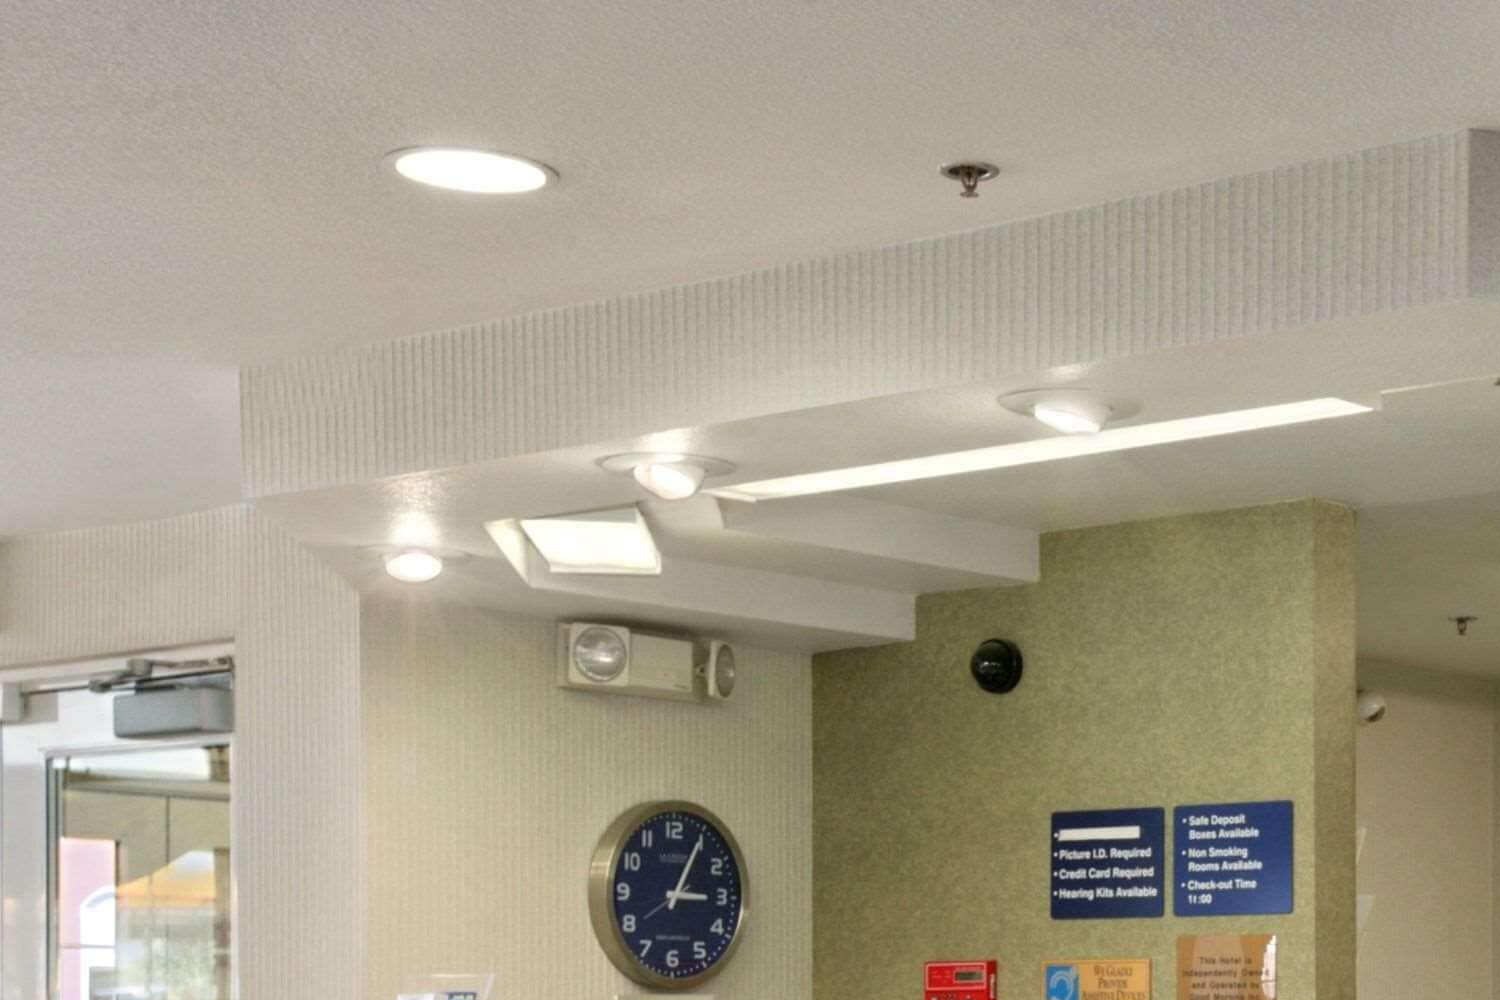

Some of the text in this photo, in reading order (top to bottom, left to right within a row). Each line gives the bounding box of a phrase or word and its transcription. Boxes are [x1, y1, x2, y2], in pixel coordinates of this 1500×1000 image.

[1188, 814, 1246, 826] Safe Deposit
[641, 829, 653, 847] 11
[665, 821, 684, 839] 12
[1189, 827, 1260, 840] Boxes Available
[1059, 847, 1152, 860] Picture I.D. Required
[1188, 846, 1248, 859] Non Smoking
[624, 852, 641, 871] 10
[711, 857, 724, 875] 2
[1188, 860, 1263, 872] Rooms Available
[1059, 866, 1155, 879] Credit Card Required
[616, 882, 630, 900] 9
[1187, 879, 1257, 890] Check-out Time
[716, 888, 728, 905] 3
[1059, 887, 1158, 901] Hearing Kits Available
[622, 914, 636, 932] 8
[710, 918, 725, 935] 4
[639, 939, 652, 957] 7
[693, 941, 707, 959] 5
[666, 950, 679, 967] 6
